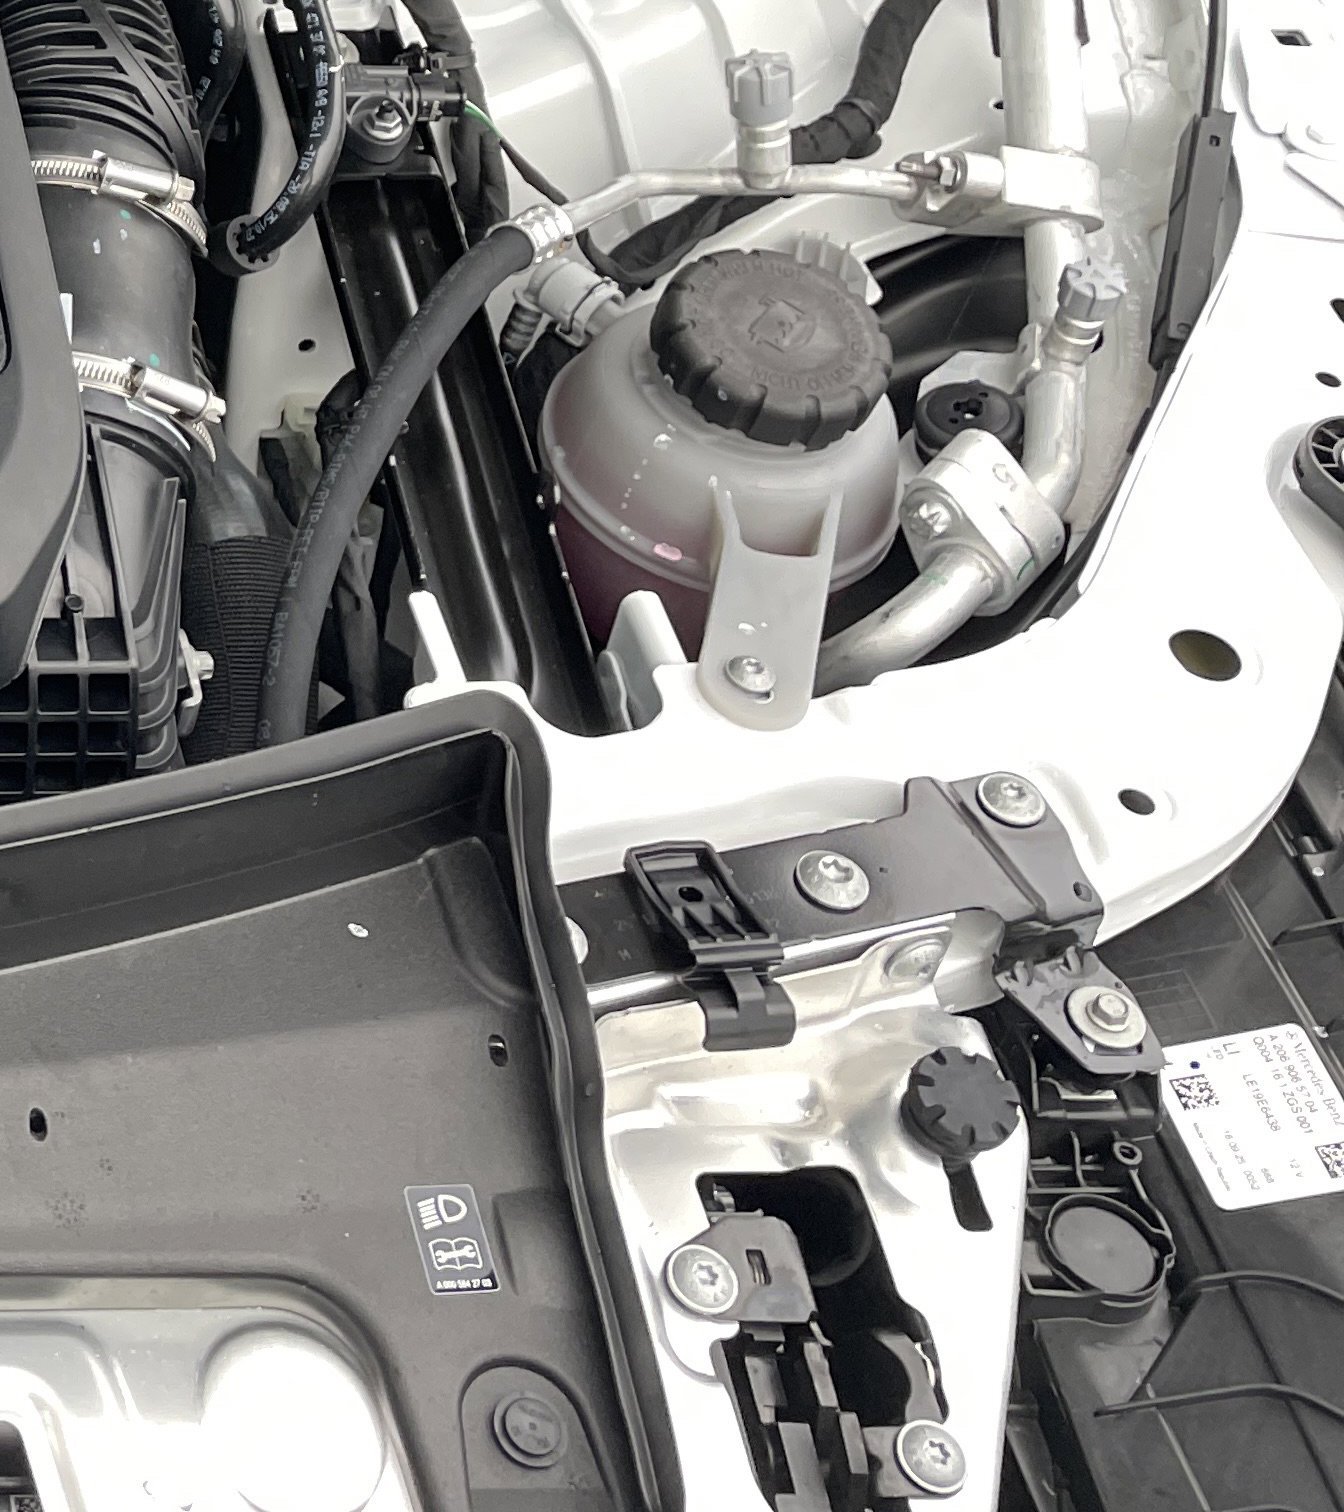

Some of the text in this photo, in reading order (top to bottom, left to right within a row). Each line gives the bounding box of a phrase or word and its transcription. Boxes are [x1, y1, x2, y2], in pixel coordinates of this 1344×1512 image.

[1268, 1034, 1279, 1042] A
[1272, 1043, 1291, 1063] 206
[1282, 1091, 1303, 1114] ZGS
[1304, 1100, 1319, 1113] 04
